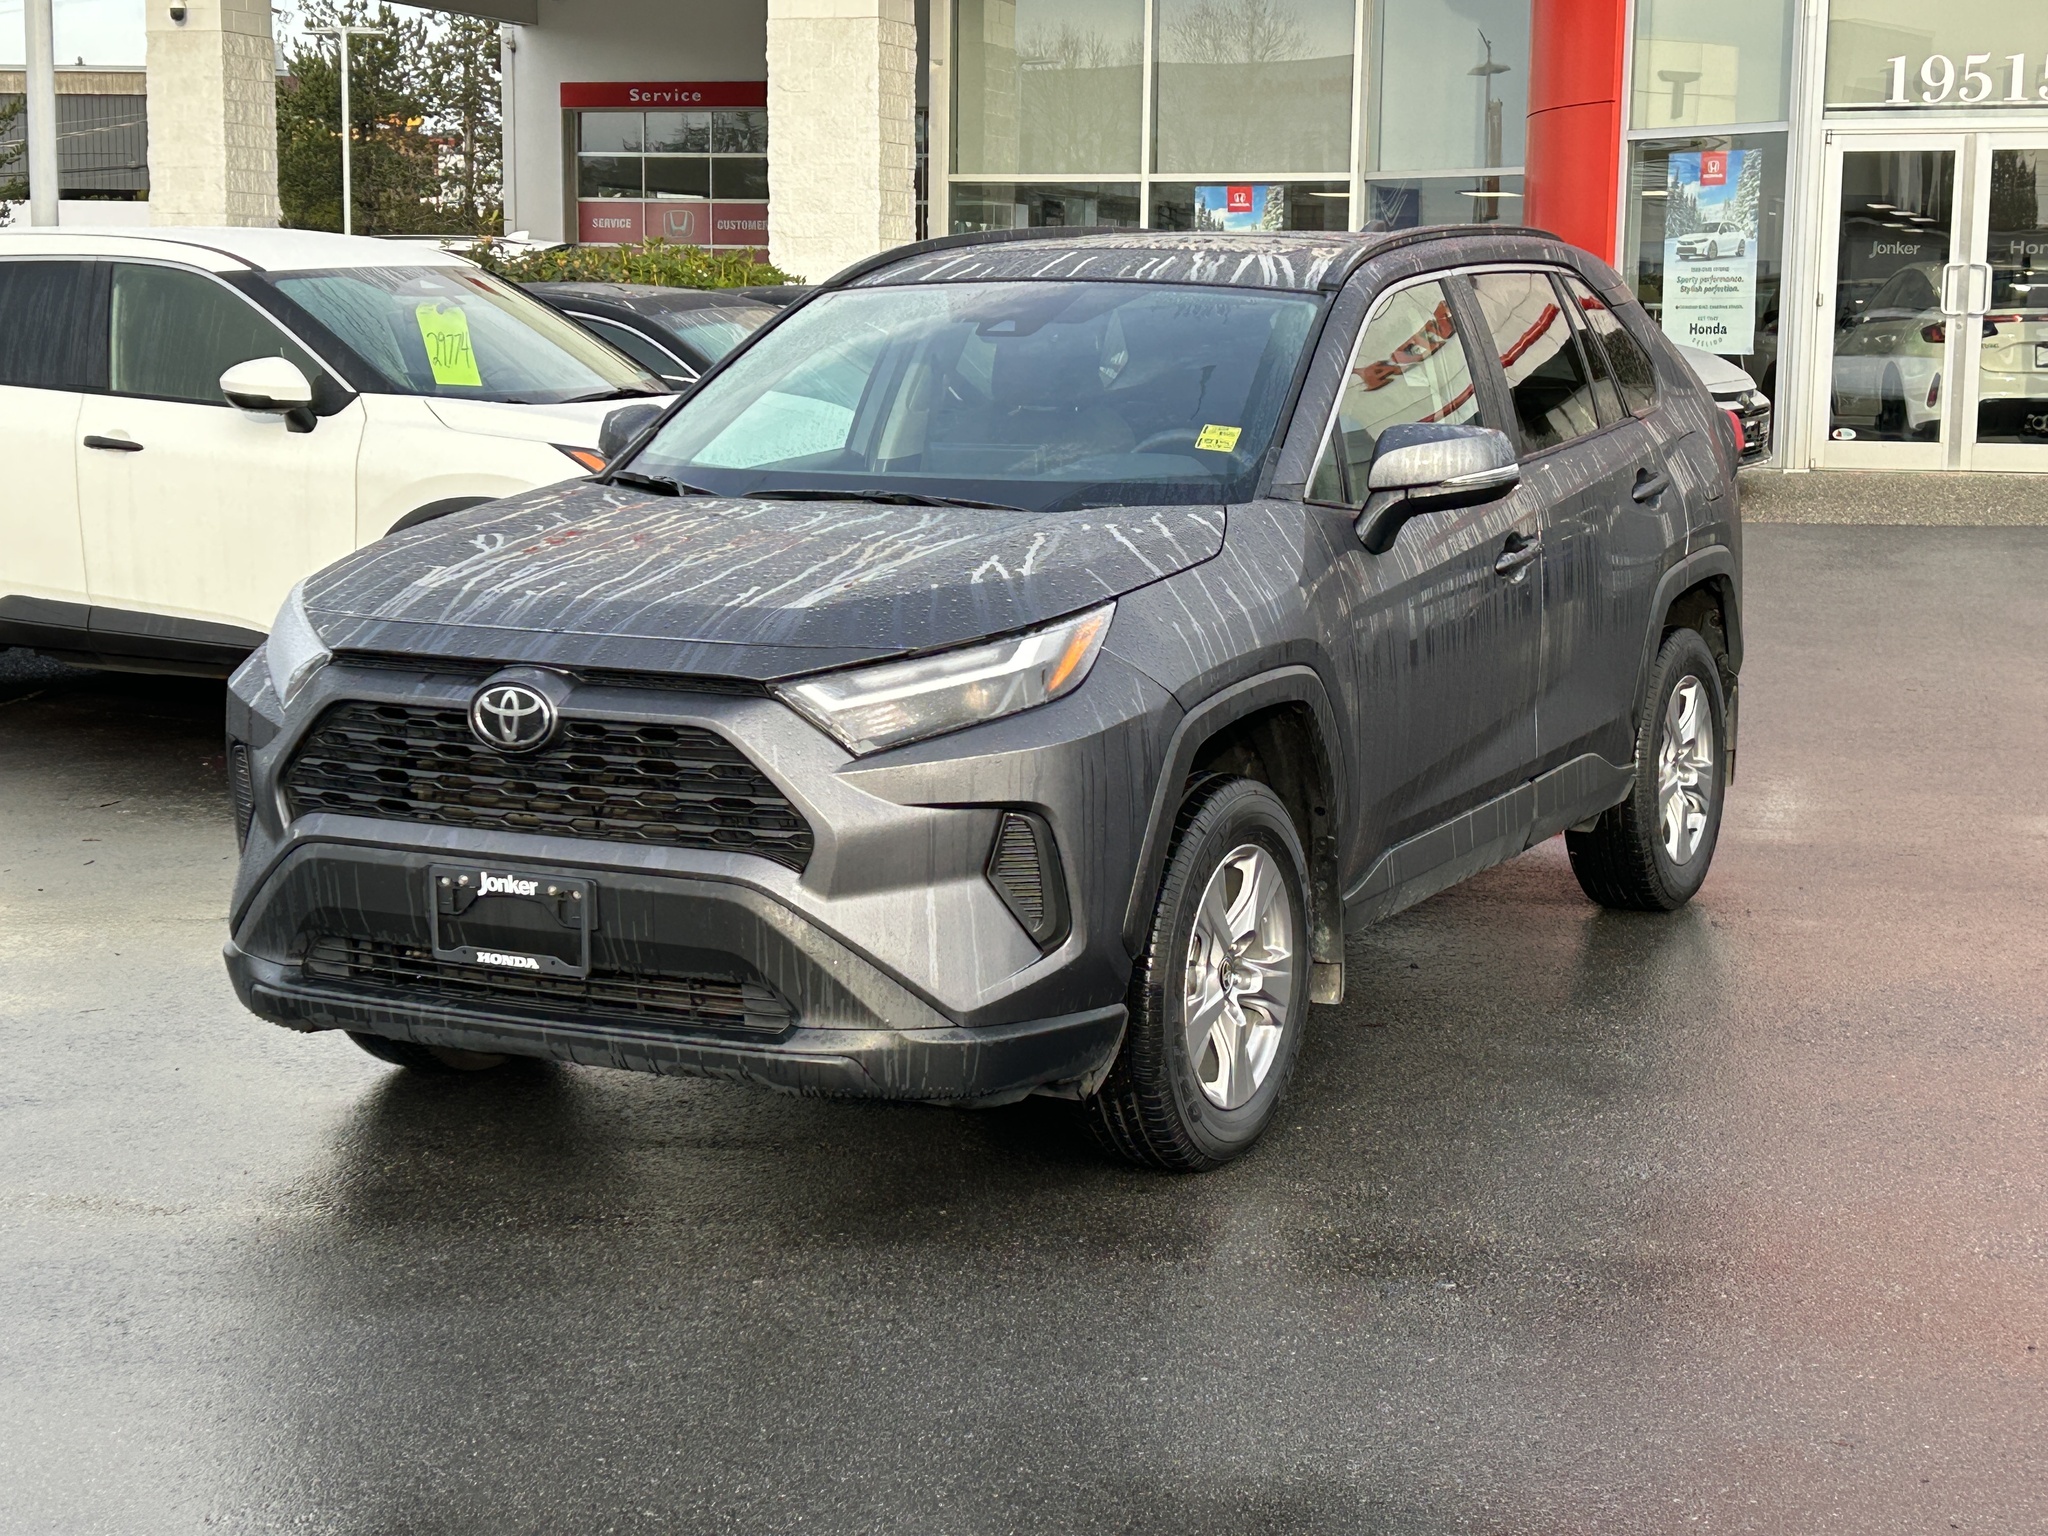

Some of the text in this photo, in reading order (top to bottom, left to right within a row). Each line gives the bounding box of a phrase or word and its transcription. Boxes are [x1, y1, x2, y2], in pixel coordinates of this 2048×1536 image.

[1885, 52, 2048, 103] 1951
[629, 88, 702, 102] Service
[592, 218, 632, 229] SERVICE
[1869, 240, 1921, 258] Jonker
[1689, 322, 1727, 335] Honda
[427, 331, 470, 369] 29774
[477, 872, 538, 896] Jonker
[476, 951, 540, 970] HONDA
